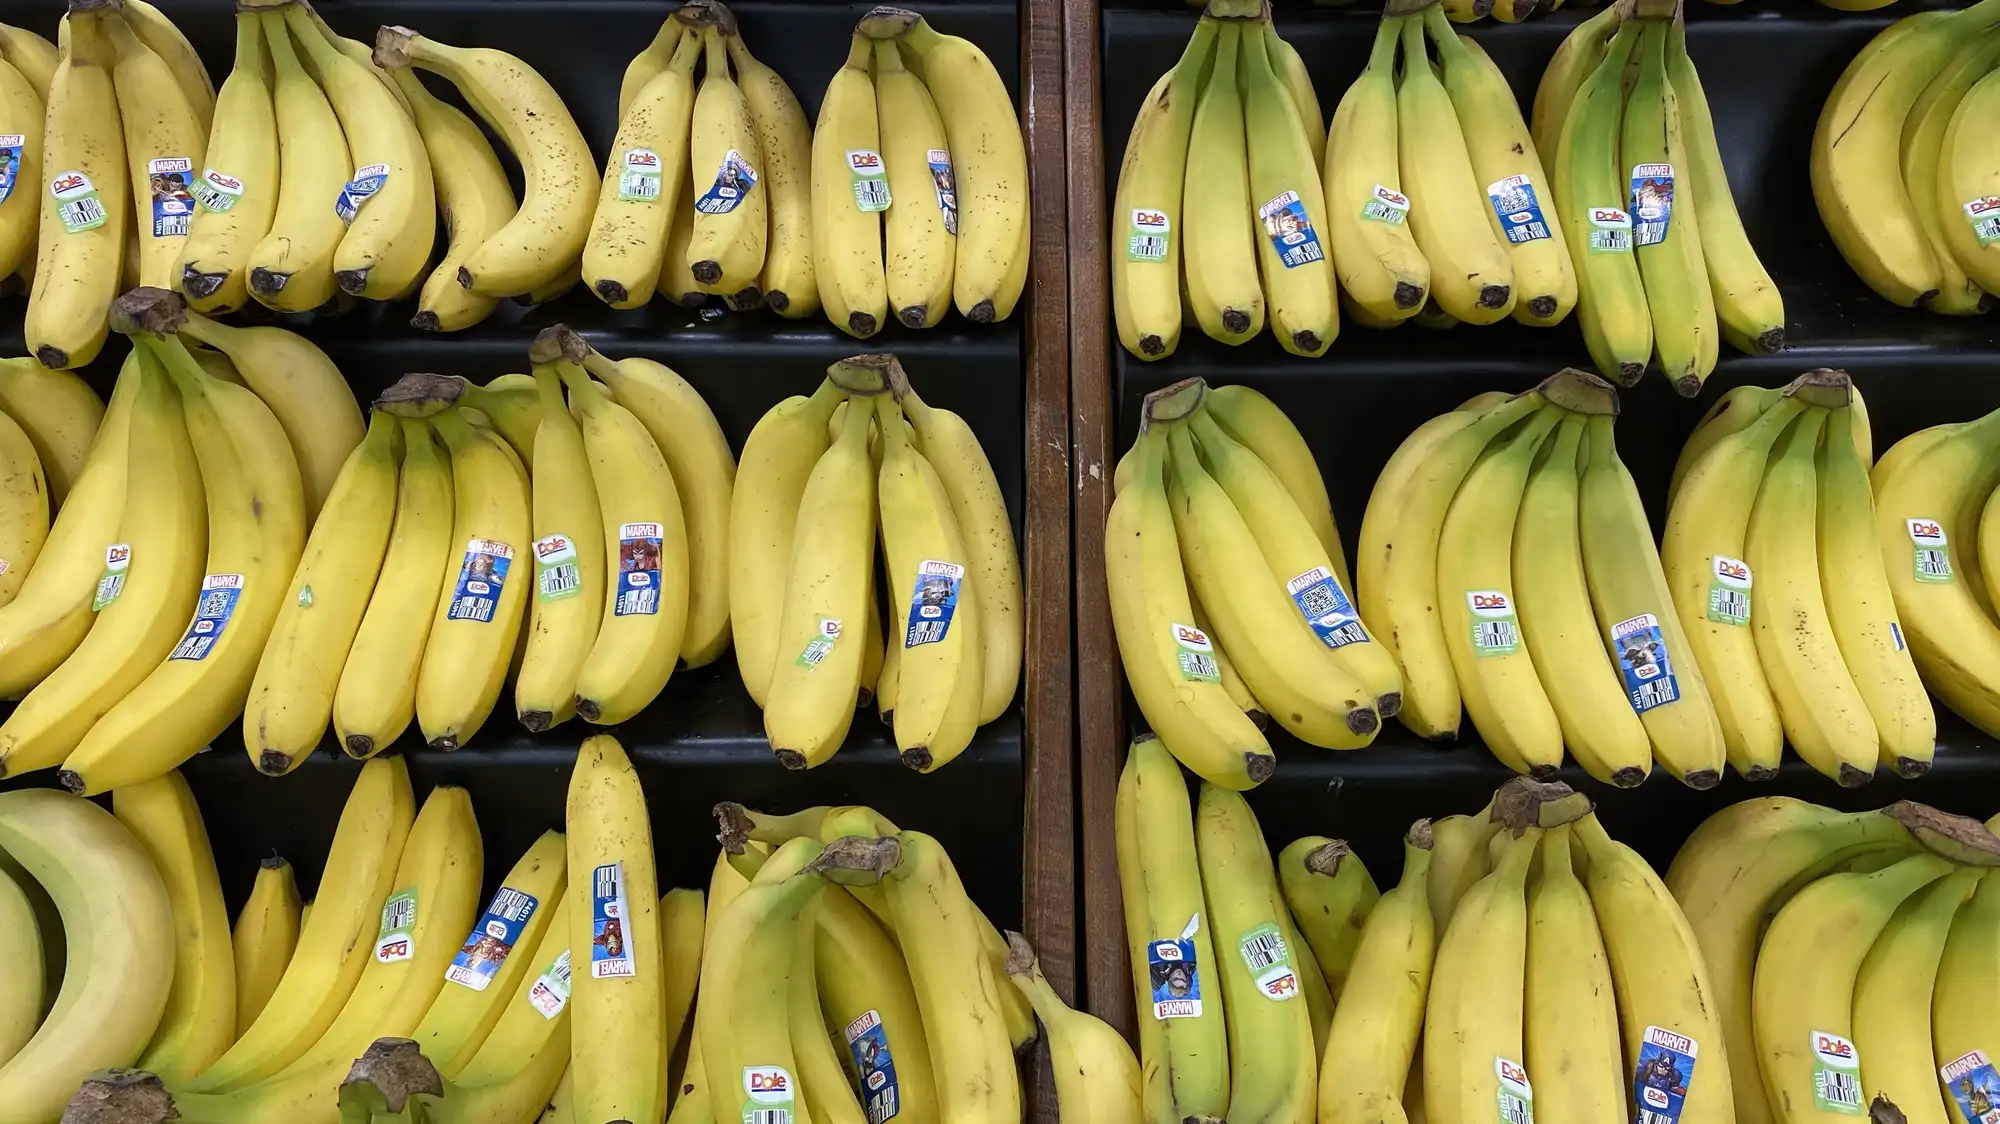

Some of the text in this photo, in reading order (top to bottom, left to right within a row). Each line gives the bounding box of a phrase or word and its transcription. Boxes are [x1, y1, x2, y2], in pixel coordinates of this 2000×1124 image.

[155, 160, 187, 171] MARVEL
[628, 153, 656, 164] Dole
[732, 153, 754, 176] MARVEL
[851, 154, 878, 165] Dole
[358, 165, 384, 178] MARVEL
[1640, 166, 1670, 177] MARVEL
[53, 175, 83, 191] Dole
[207, 172, 240, 189] Dole
[1263, 193, 1291, 213] MARVEL
[1378, 188, 1405, 205] Dole
[1137, 212, 1164, 223] Dole
[1595, 211, 1624, 221] Dole
[626, 525, 657, 537] MARVEL
[1913, 523, 1940, 534] Dole
[109, 547, 128, 560] Dole
[537, 538, 566, 554] Dole
[926, 562, 957, 576] MARVEL
[1719, 560, 1746, 577] Dole
[1915, 550, 1924, 572] #4011
[210, 576, 237, 587] MARVEL
[1292, 569, 1322, 591] MARVEL
[616, 595, 625, 613] #4011
[1474, 595, 1505, 606] Dole
[1711, 589, 1719, 612] #4011
[1178, 628, 1205, 642] Dole
[1616, 617, 1648, 637] MARVEL
[907, 626, 915, 645] #4011
[1473, 625, 1482, 647] #4011
[1639, 665, 1656, 676] Dole
[1632, 689, 1641, 709] #4011
[519, 901, 534, 922] #4011
[488, 924, 506, 936] Dole
[380, 943, 407, 959] Dole
[1160, 949, 1178, 958] Dole
[1160, 1002, 1193, 1017] MARVEL
[849, 1013, 872, 1036] MARVEL
[1653, 1029, 1690, 1053] MARVEL
[1819, 1036, 1851, 1055] Dole
[1946, 1053, 1981, 1079] MARVEL
[751, 1072, 786, 1088] Dole
[870, 1073, 883, 1085] Dole
[1815, 1072, 1824, 1099] #4011
[1648, 1091, 1667, 1103] Dole
